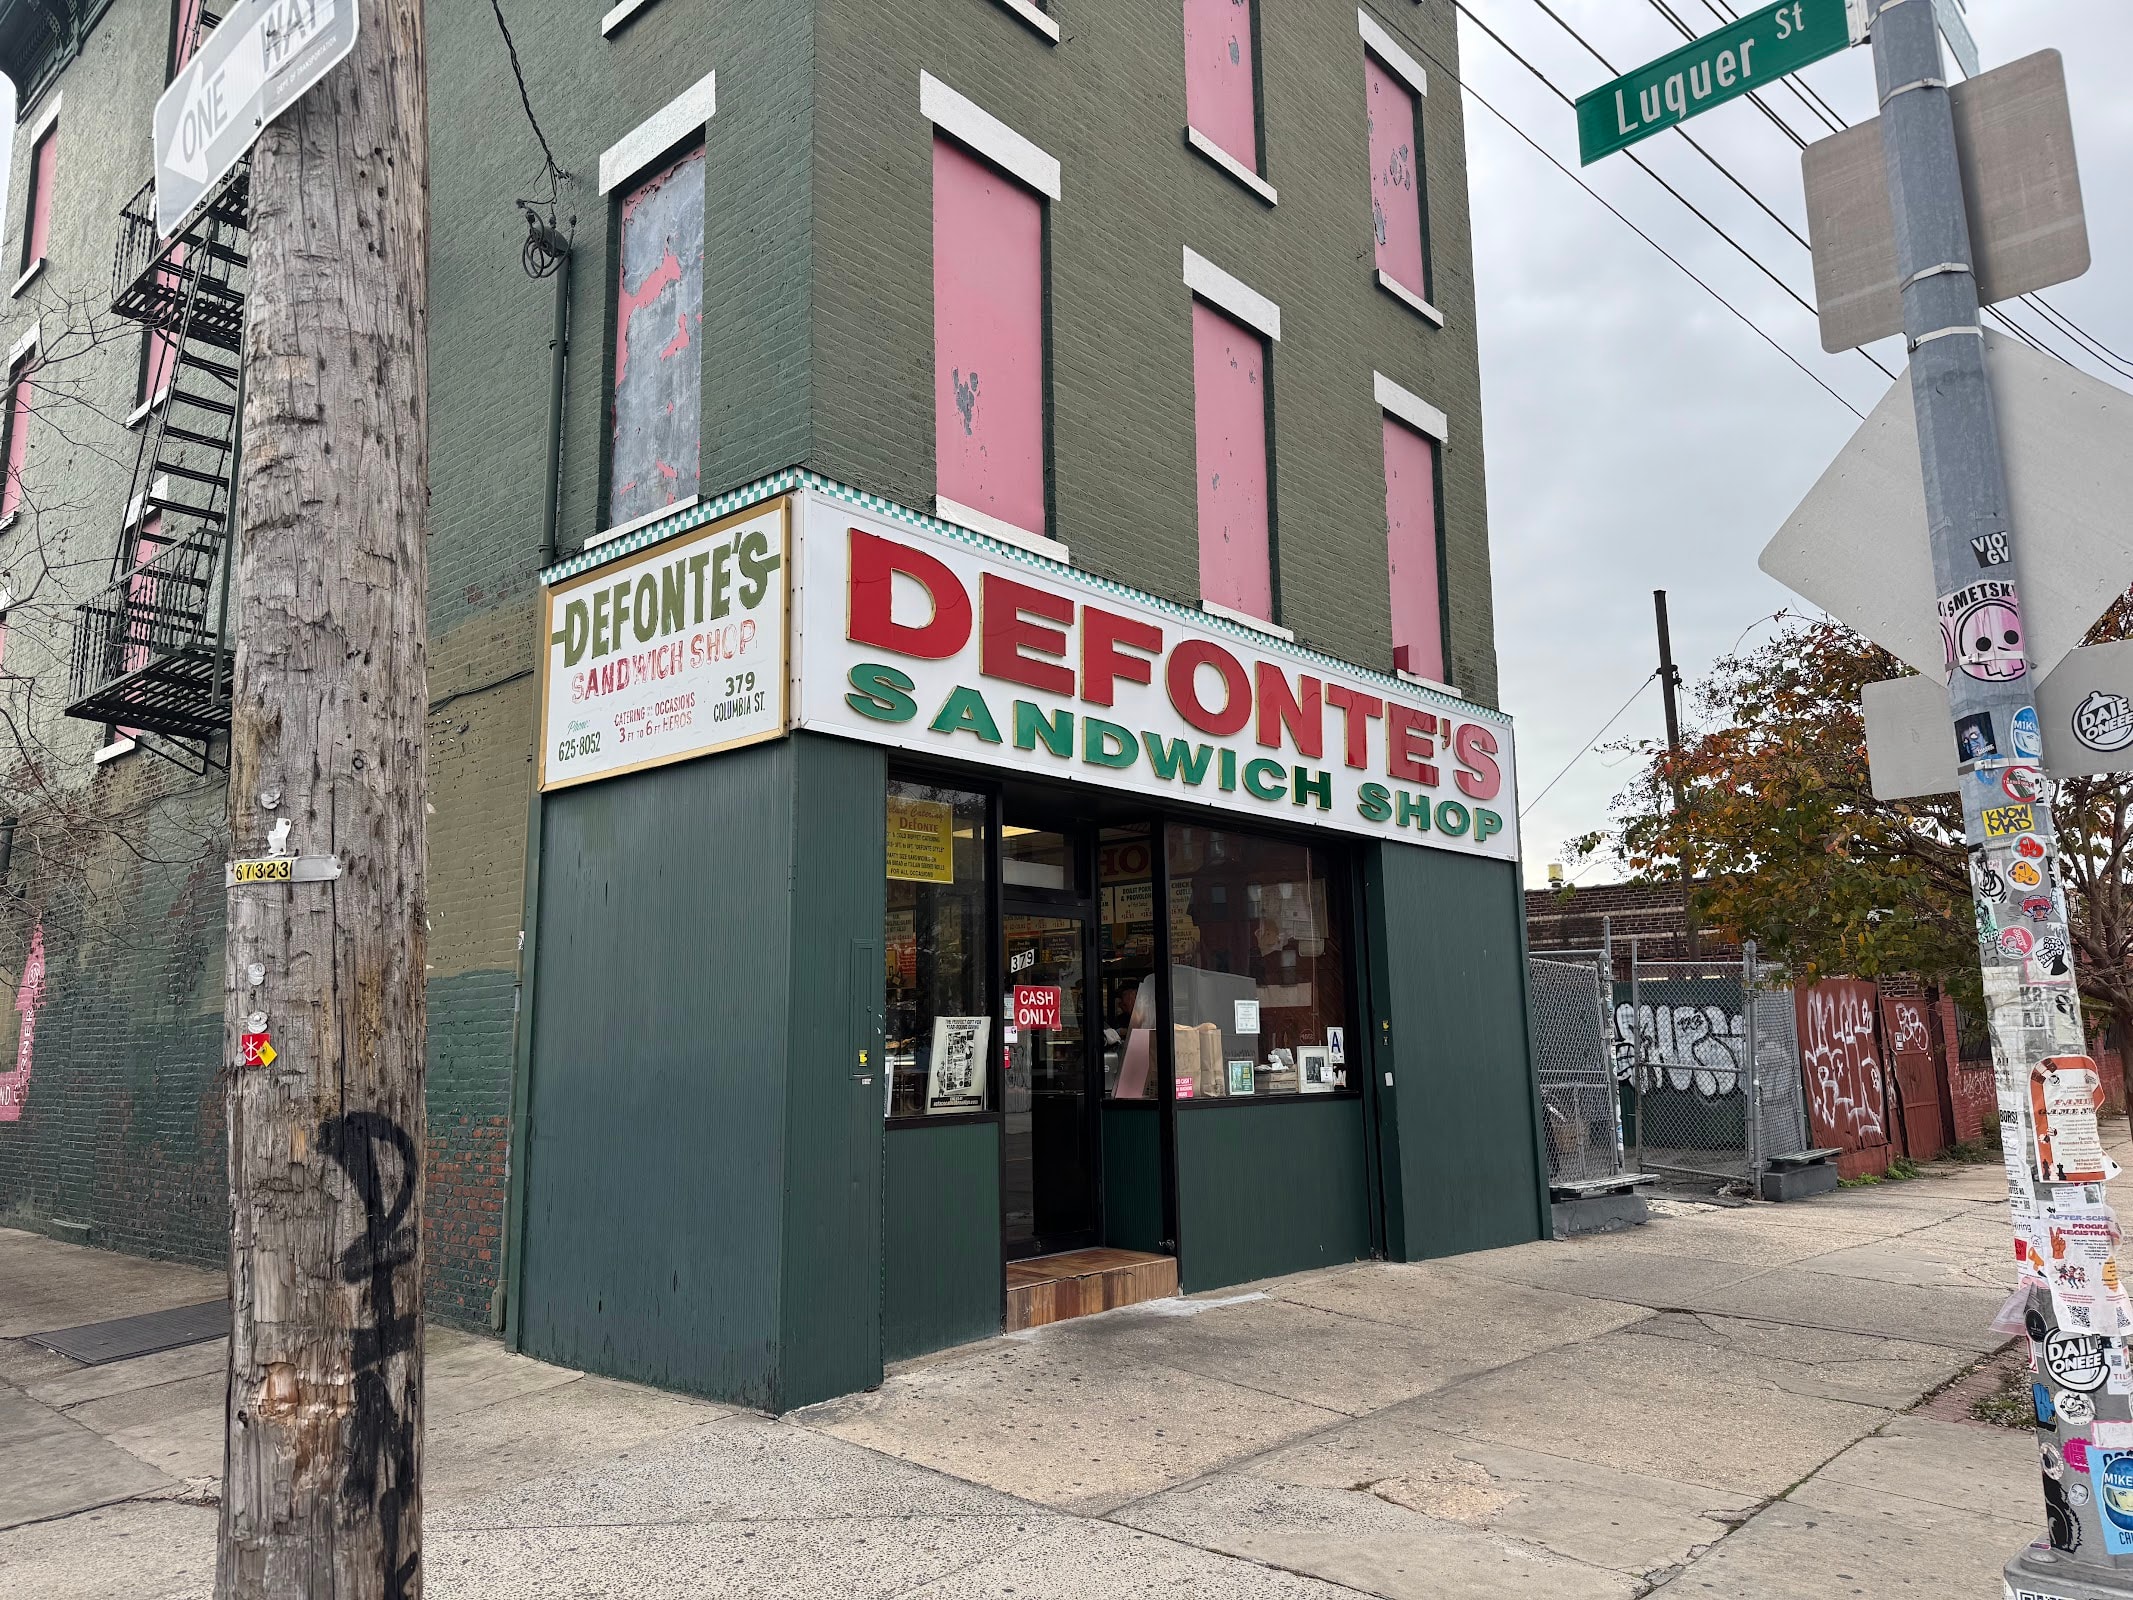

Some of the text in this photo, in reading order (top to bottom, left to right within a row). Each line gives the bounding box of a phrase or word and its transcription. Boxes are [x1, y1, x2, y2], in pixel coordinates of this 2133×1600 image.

[1615, 1, 1804, 137] Luquer St
[183, 68, 228, 163] ONE
[563, 531, 769, 669] DEFONTE'S
[571, 619, 757, 704] SANDWICH SHOP
[846, 527, 1501, 799] DEFONTE'S
[725, 671, 755, 697] 379
[614, 705, 646, 726] CATERING
[654, 692, 696, 717] OCCASIONS
[713, 696, 751, 724] COLUMBIA
[619, 727, 627, 743] 3
[646, 724, 653, 738] 6
[663, 711, 692, 734] HEROS
[845, 663, 1503, 841] SANDWICH SHOP
[1986, 804, 2029, 822] KNOW
[1987, 818, 2032, 835] MAD
[235, 861, 290, 881] 67323
[1012, 951, 1033, 970] 379
[1019, 990, 1054, 1006] CASH
[1018, 1008, 1056, 1026] ONLY
[1332, 1032, 1341, 1053] A
[2051, 1352, 2103, 1373] ONEEE
